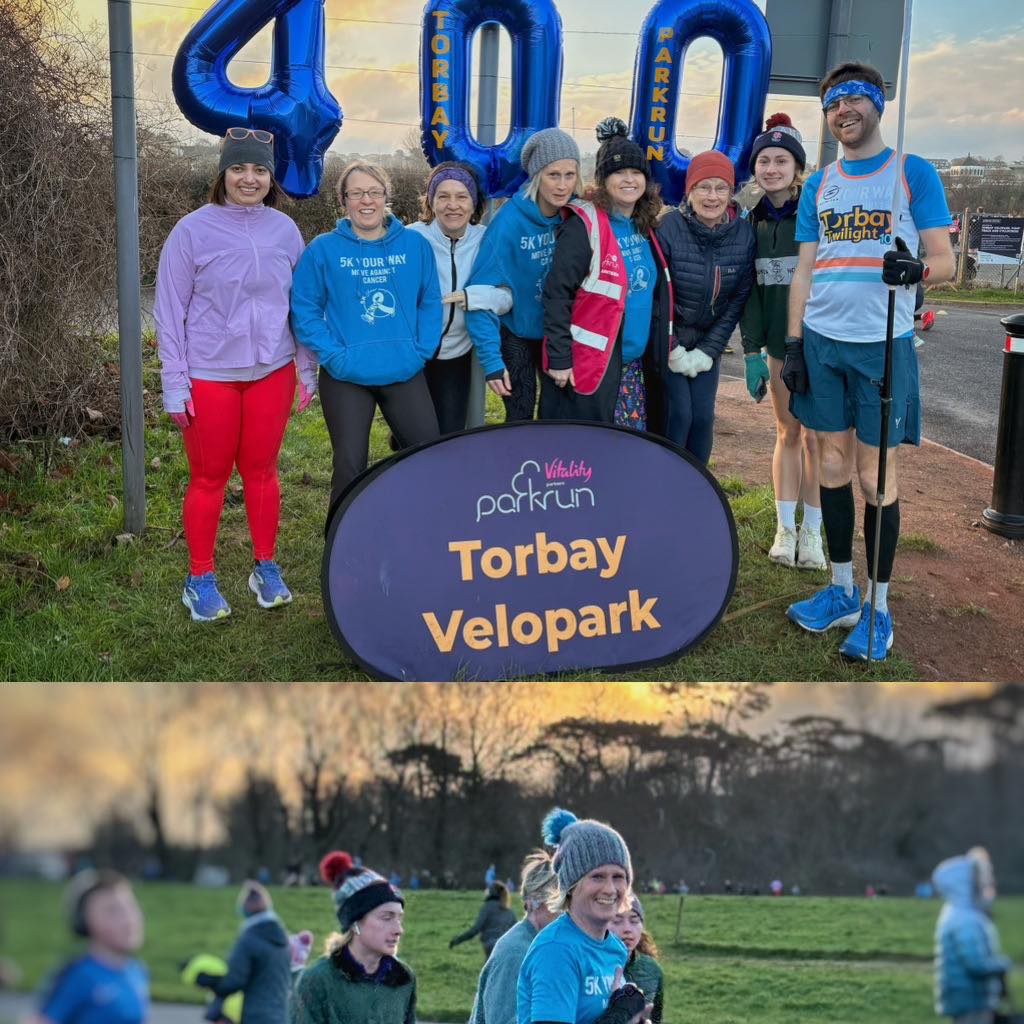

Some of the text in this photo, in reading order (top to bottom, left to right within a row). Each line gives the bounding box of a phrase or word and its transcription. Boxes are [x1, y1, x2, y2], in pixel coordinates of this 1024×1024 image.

[431, 11, 450, 149] TORBAY
[646, 27, 674, 161] PARKRUN
[520, 231, 556, 250] 5K YOU
[825, 226, 879, 243] Twilight
[340, 257, 354, 268] 5K
[545, 458, 592, 483] Vitality
[476, 478, 595, 523] parkrun
[448, 532, 627, 581] Torbay
[422, 589, 661, 653] Velopark
[584, 976, 603, 996] 5K
